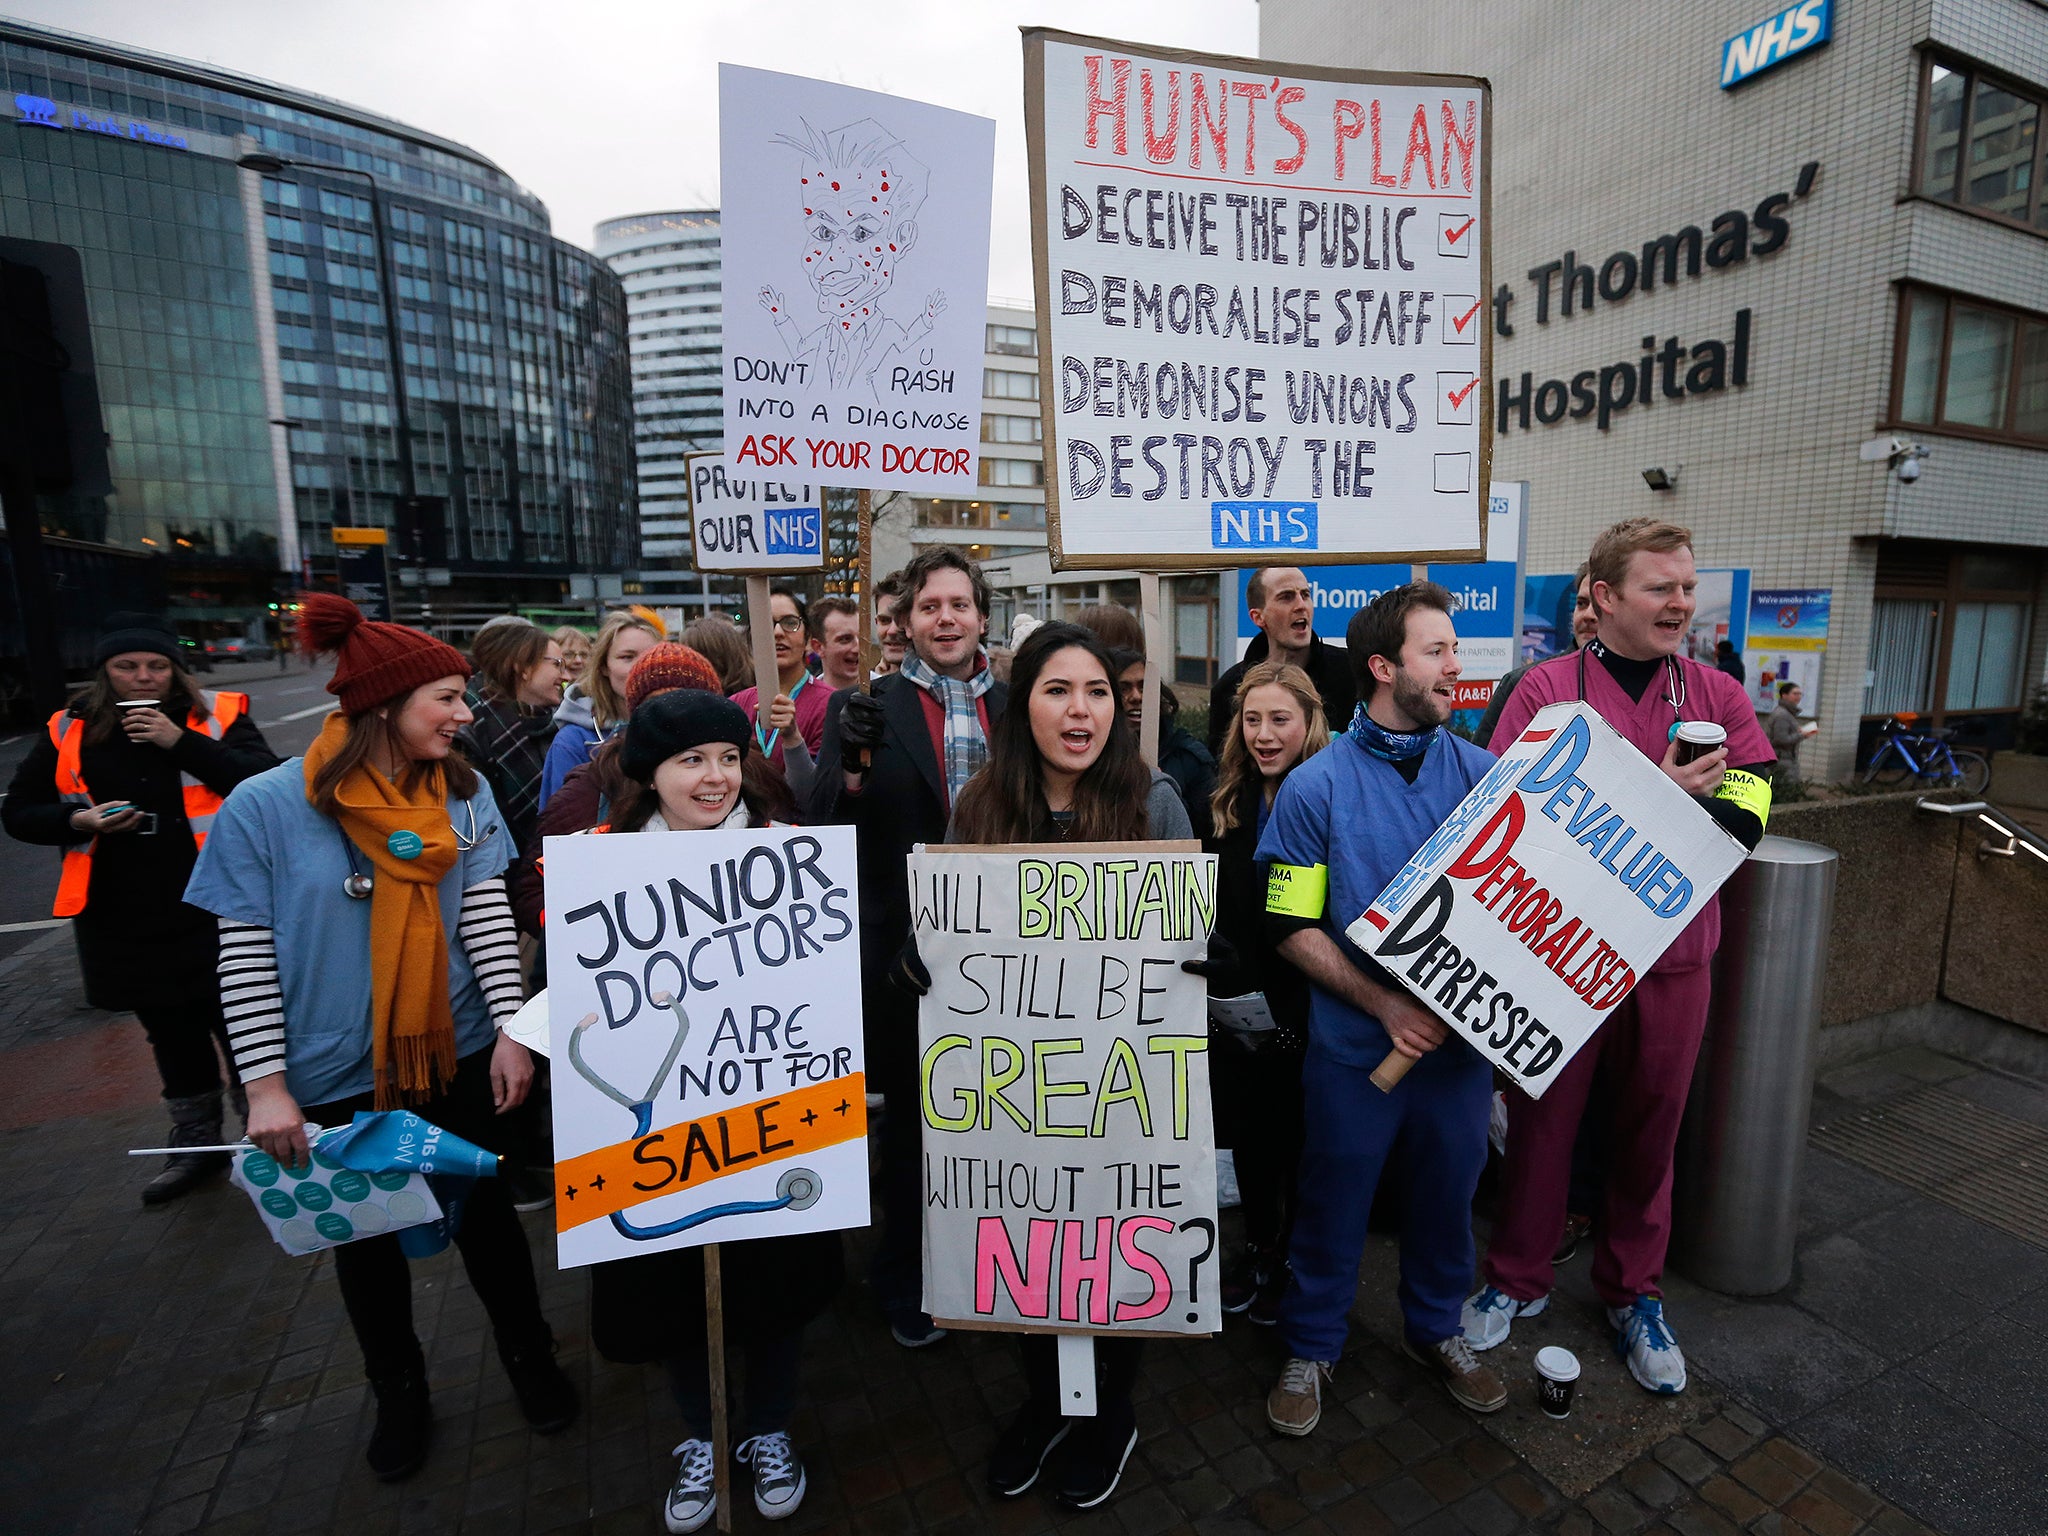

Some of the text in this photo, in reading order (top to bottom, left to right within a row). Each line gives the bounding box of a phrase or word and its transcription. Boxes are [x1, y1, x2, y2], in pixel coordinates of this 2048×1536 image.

[1721, 0, 1823, 84] NHS
[73, 111, 187, 148] Park Plaza
[1083, 55, 1477, 191] HUNT'S PLAN
[1061, 183, 1417, 270] DECEIVE THE PUBLIC
[1493, 161, 1820, 337] t Thomas'
[1061, 270, 1435, 348] DEMORALISE STAFF
[733, 355, 955, 394] DON'T RASH
[1062, 355, 1417, 433] DEMONISE UNIONS
[1497, 308, 1752, 434] Hospital
[738, 398, 970, 431] INTO A DIAGNOSE
[736, 434, 972, 476] ASK YOUR DOCTOR
[1067, 433, 1377, 500] DESTROY THE
[699, 513, 817, 553] OUR NHS
[1219, 507, 1310, 544] NHS
[1489, 498, 1508, 512] HS
[1467, 648, 1506, 657] PARTNERS
[1459, 687, 1491, 703] (A&E)
[1516, 714, 1694, 919] DEVALUED
[1723, 772, 1756, 787] BMA
[564, 835, 833, 969] JUNIOR
[914, 860, 1216, 941] WILL BRITAIN
[1444, 790, 1637, 1011] DEMORALISED
[595, 888, 853, 1030] DOCTORS
[948, 953, 1176, 1026] STILL BE
[1375, 874, 1564, 1078] DEPRESSED
[708, 1003, 812, 1056] ARE
[680, 1046, 853, 1101] NOT FOR
[920, 1034, 1208, 1140] GREAT
[632, 1101, 795, 1192] SALE
[926, 1152, 1183, 1213] WITHOUT THE
[974, 1215, 1217, 1325] NHS?
